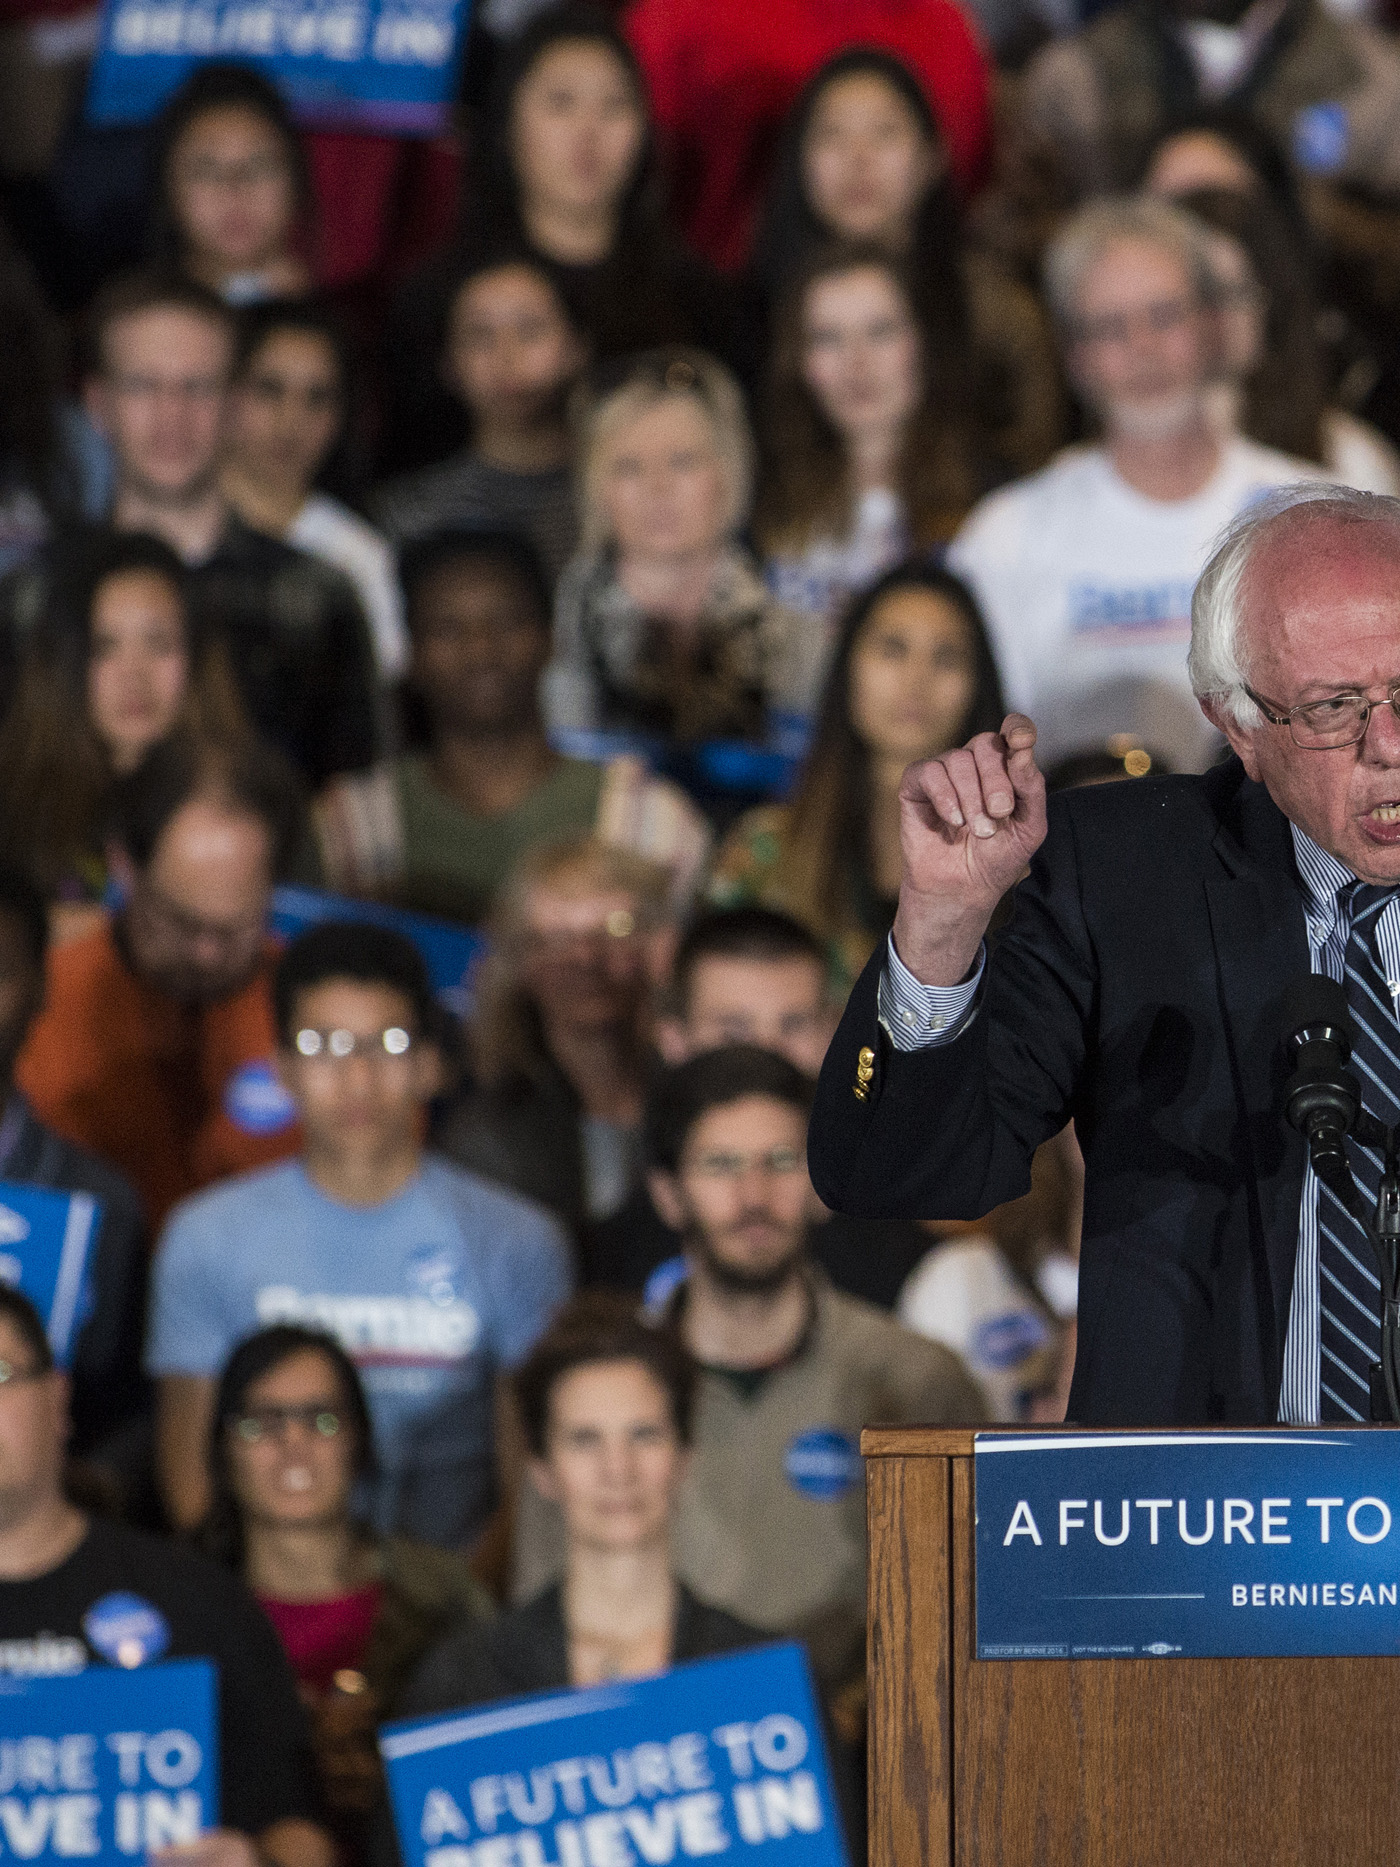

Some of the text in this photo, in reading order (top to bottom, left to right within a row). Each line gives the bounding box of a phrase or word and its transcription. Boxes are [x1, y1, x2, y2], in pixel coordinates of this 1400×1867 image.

[1003, 1501, 1042, 1546] A
[1059, 1499, 1291, 1546] FUTURE
[1306, 1497, 1392, 1544] TO
[105, 1729, 203, 1788] TO
[420, 1713, 808, 1845] A FUTURE TO
[114, 1788, 200, 1857] IN
[734, 1770, 821, 1845] IN
